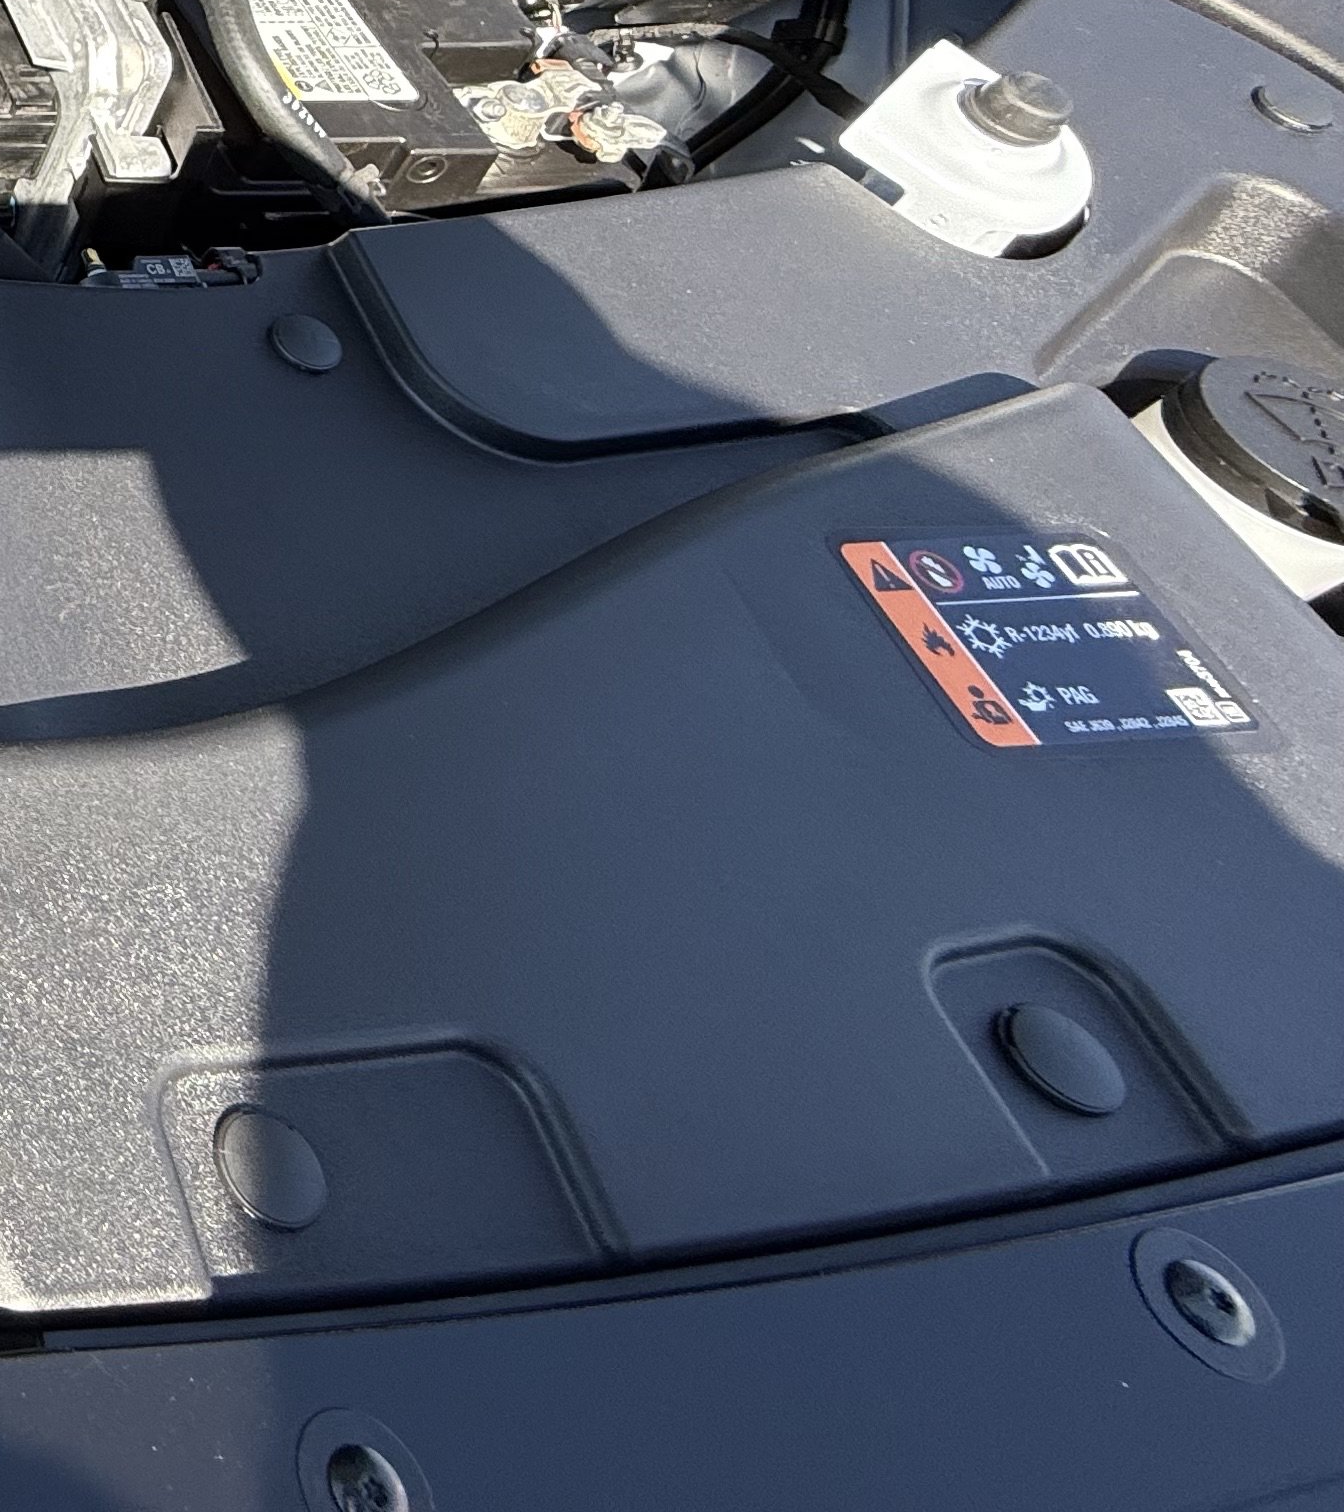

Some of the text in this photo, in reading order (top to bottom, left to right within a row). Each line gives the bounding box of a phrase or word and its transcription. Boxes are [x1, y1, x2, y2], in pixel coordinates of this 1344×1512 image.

[981, 574, 1021, 590] AUTO
[1003, 623, 1081, 644] R-1234yf
[1125, 619, 1160, 641] kg
[1056, 685, 1101, 705] PAG
